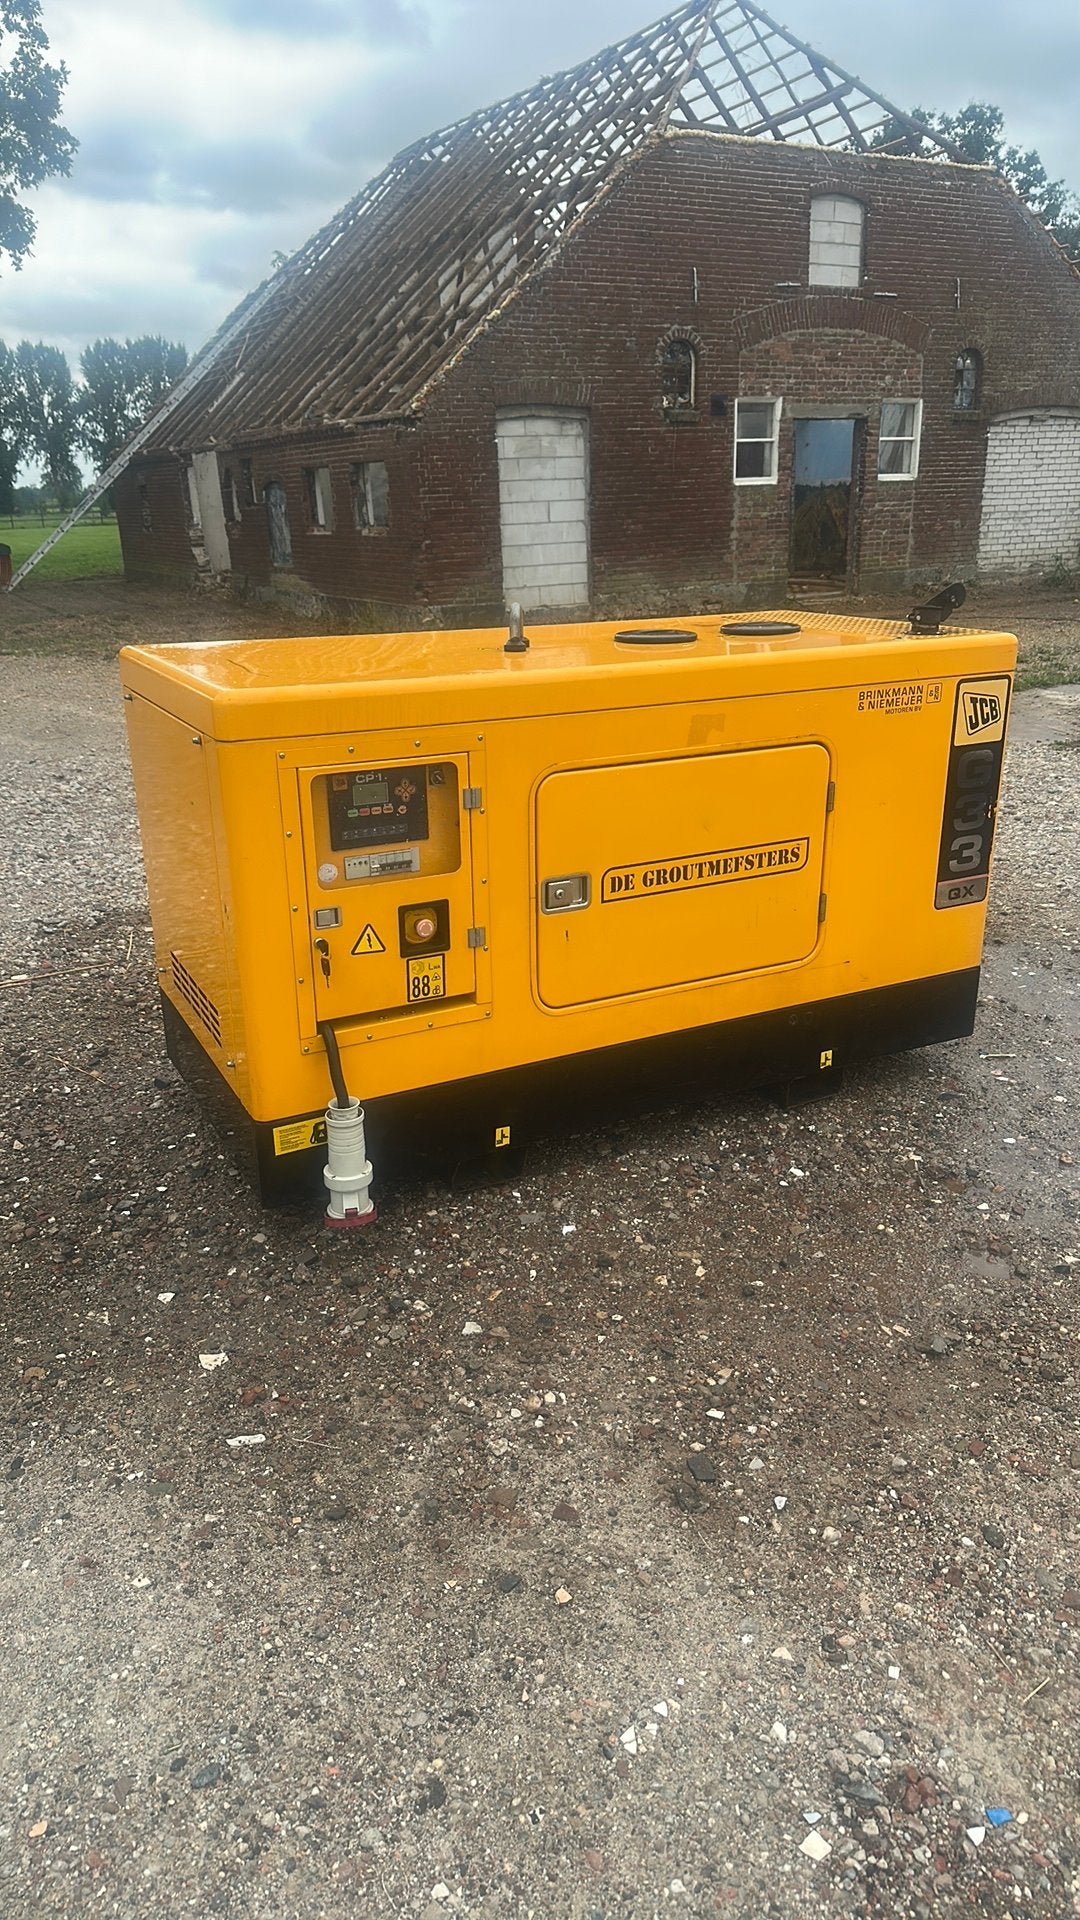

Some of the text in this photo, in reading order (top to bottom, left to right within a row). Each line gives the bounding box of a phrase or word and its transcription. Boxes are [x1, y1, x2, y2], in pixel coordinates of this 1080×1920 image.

[859, 685, 924, 700] BRINKMANN
[858, 695, 923, 711] & NIEMEIJER
[885, 707, 913, 715] MOTOREN
[968, 696, 1000, 731] JCB
[610, 873, 635, 893] DE
[948, 885, 975, 900] QX
[412, 975, 430, 998] 88
